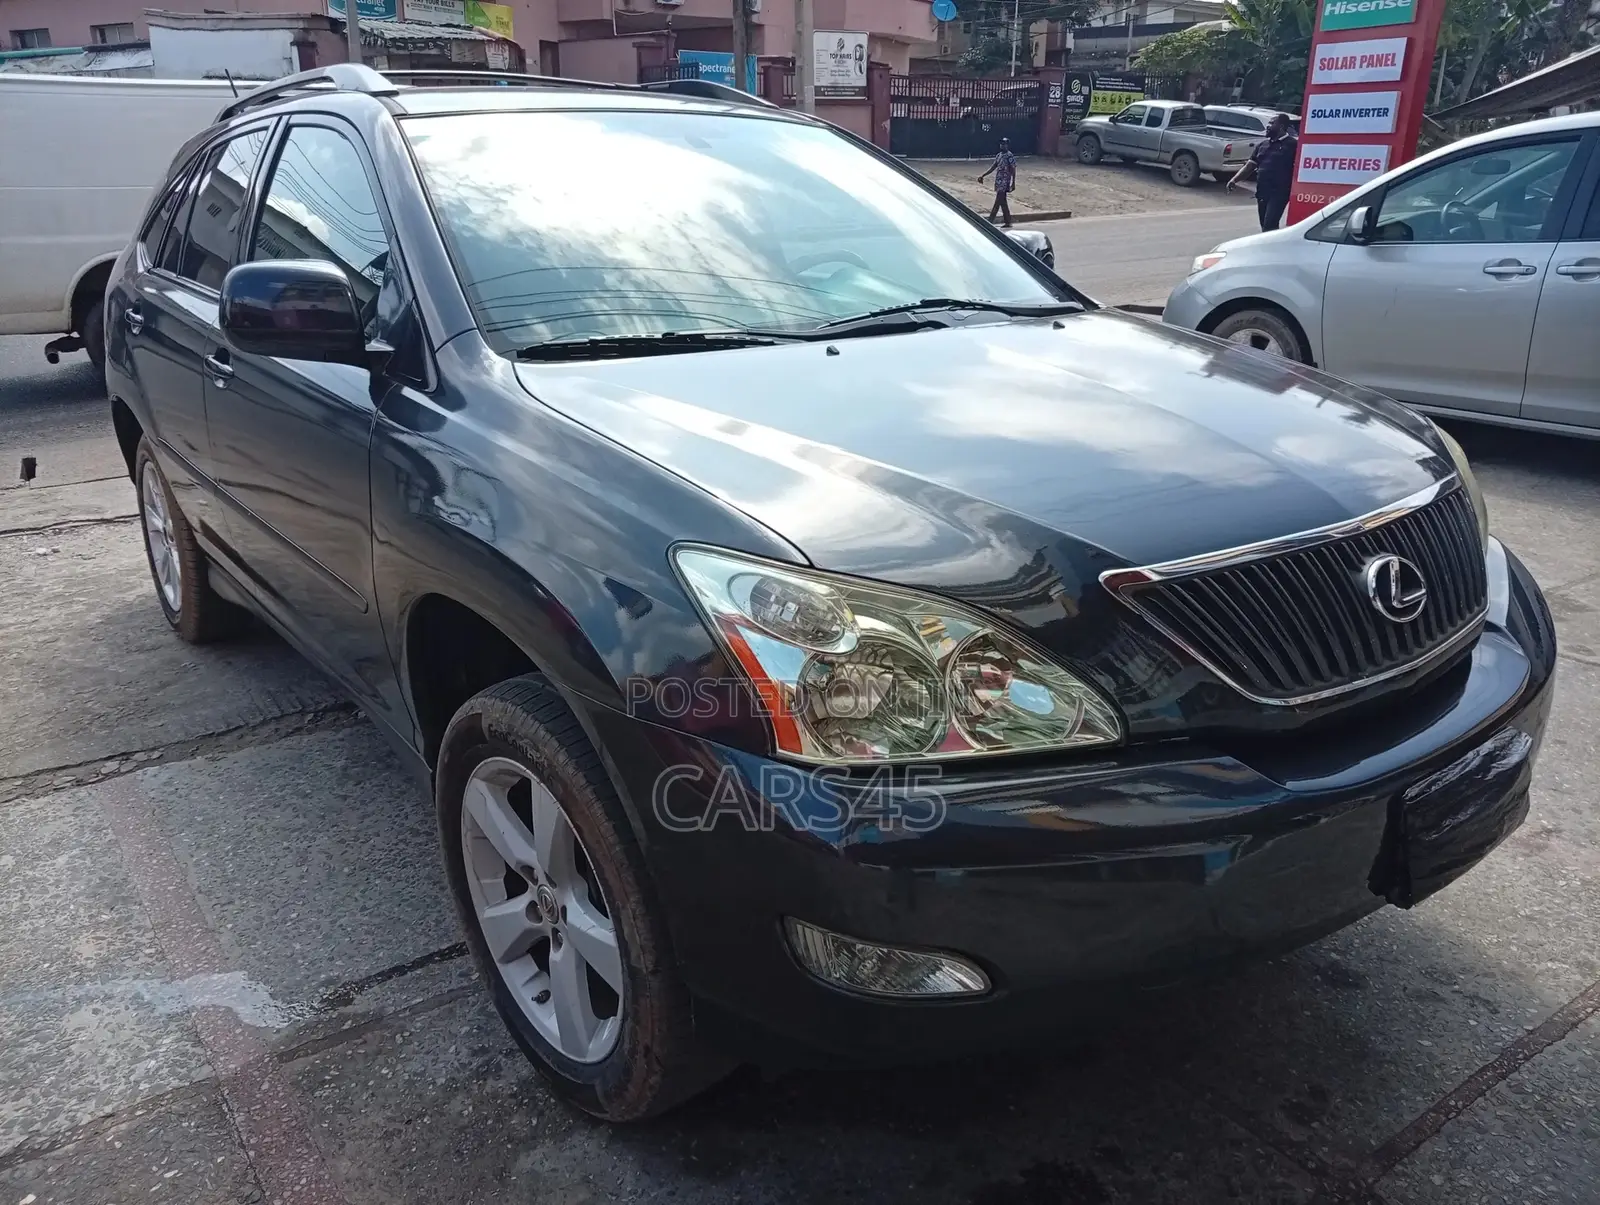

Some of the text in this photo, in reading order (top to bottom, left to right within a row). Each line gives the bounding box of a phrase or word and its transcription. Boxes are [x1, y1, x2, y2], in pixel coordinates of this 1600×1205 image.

[1324, 0, 1412, 16] Hisense
[698, 62, 736, 74] Spectrane
[1319, 52, 1397, 72] SOLAR PANEL
[1311, 107, 1389, 119] SOLAR INVERTER
[1303, 157, 1381, 171] BATTERIES
[1297, 193, 1325, 204] 0902
